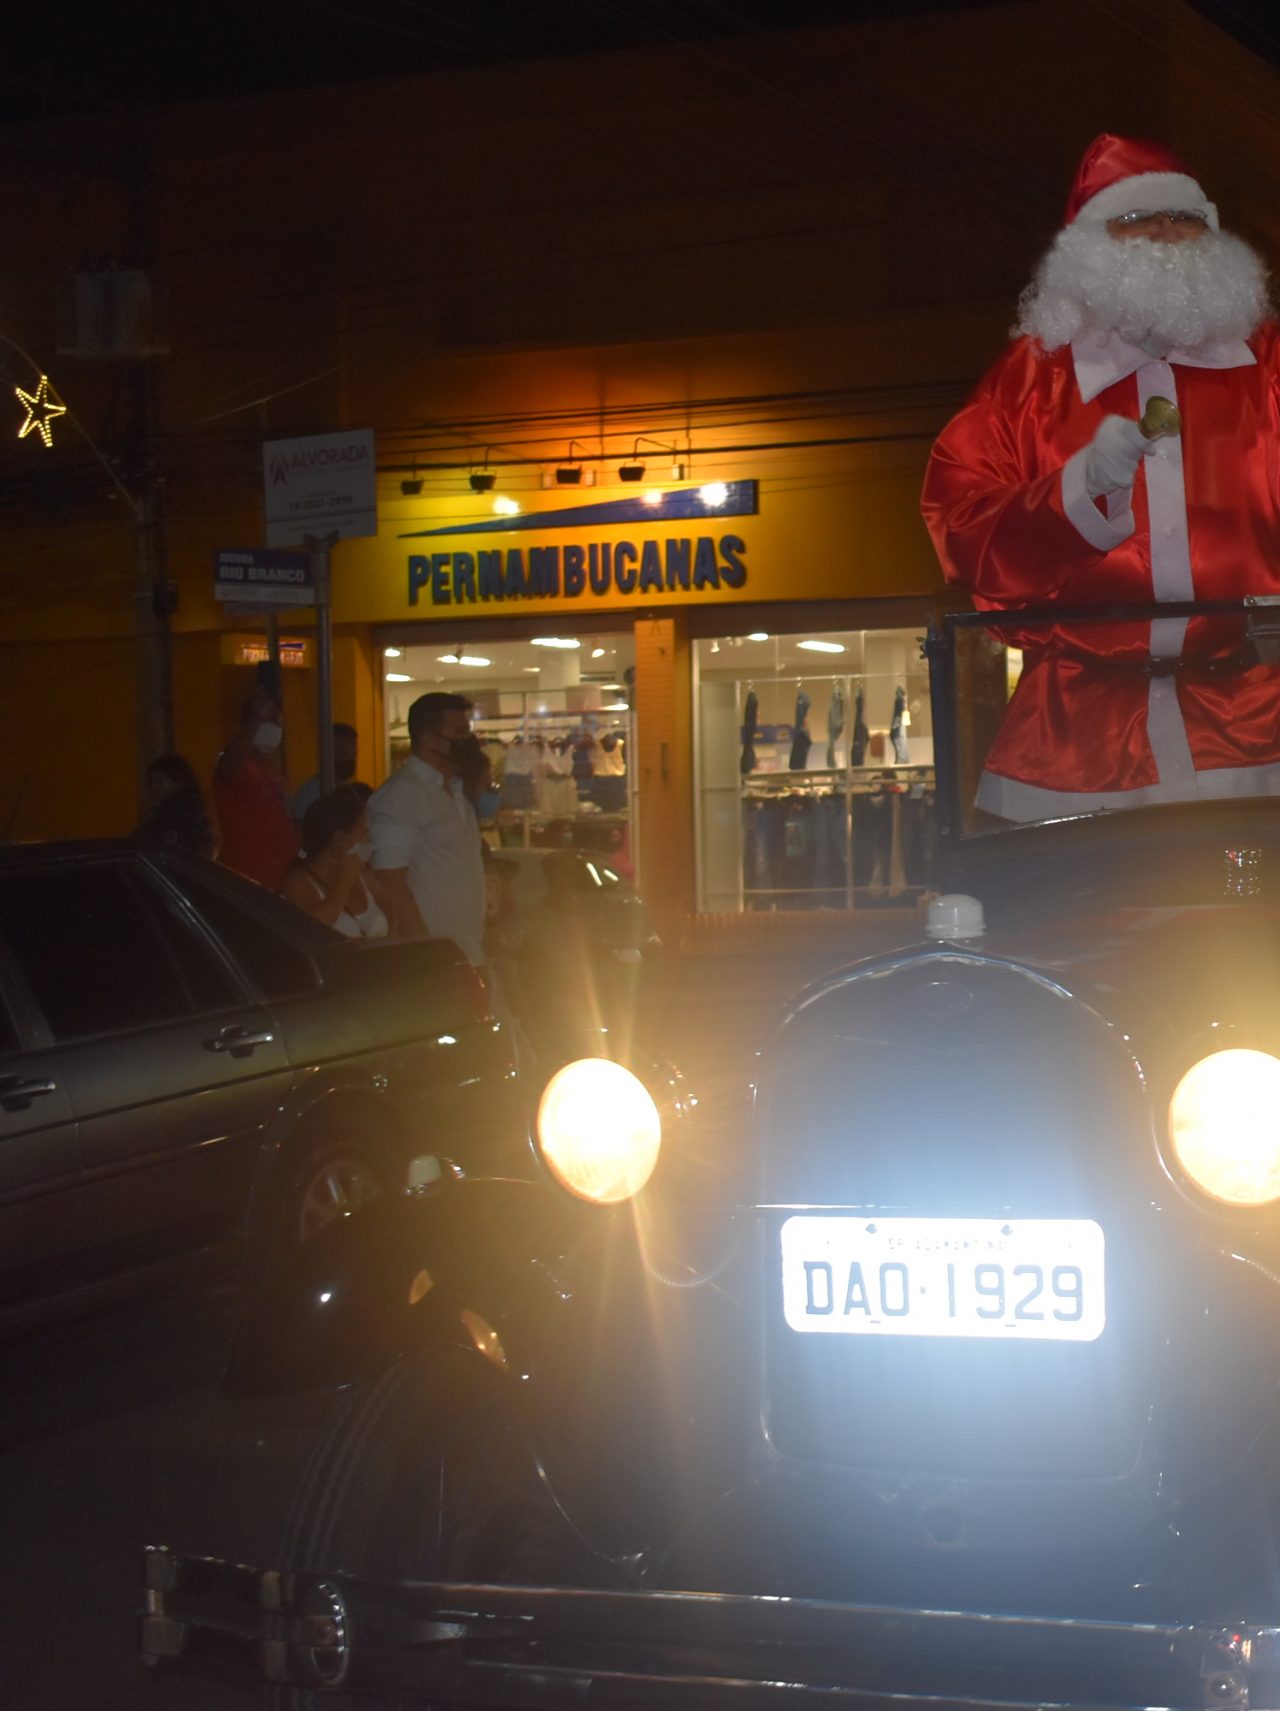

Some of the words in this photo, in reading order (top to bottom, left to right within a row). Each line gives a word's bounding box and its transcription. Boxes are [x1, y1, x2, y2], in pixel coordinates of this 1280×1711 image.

[291, 445, 368, 468] ALVORADA
[219, 566, 244, 580] RIO
[247, 567, 305, 583] BRANCO
[408, 535, 747, 606] PERNAMBUCANAS
